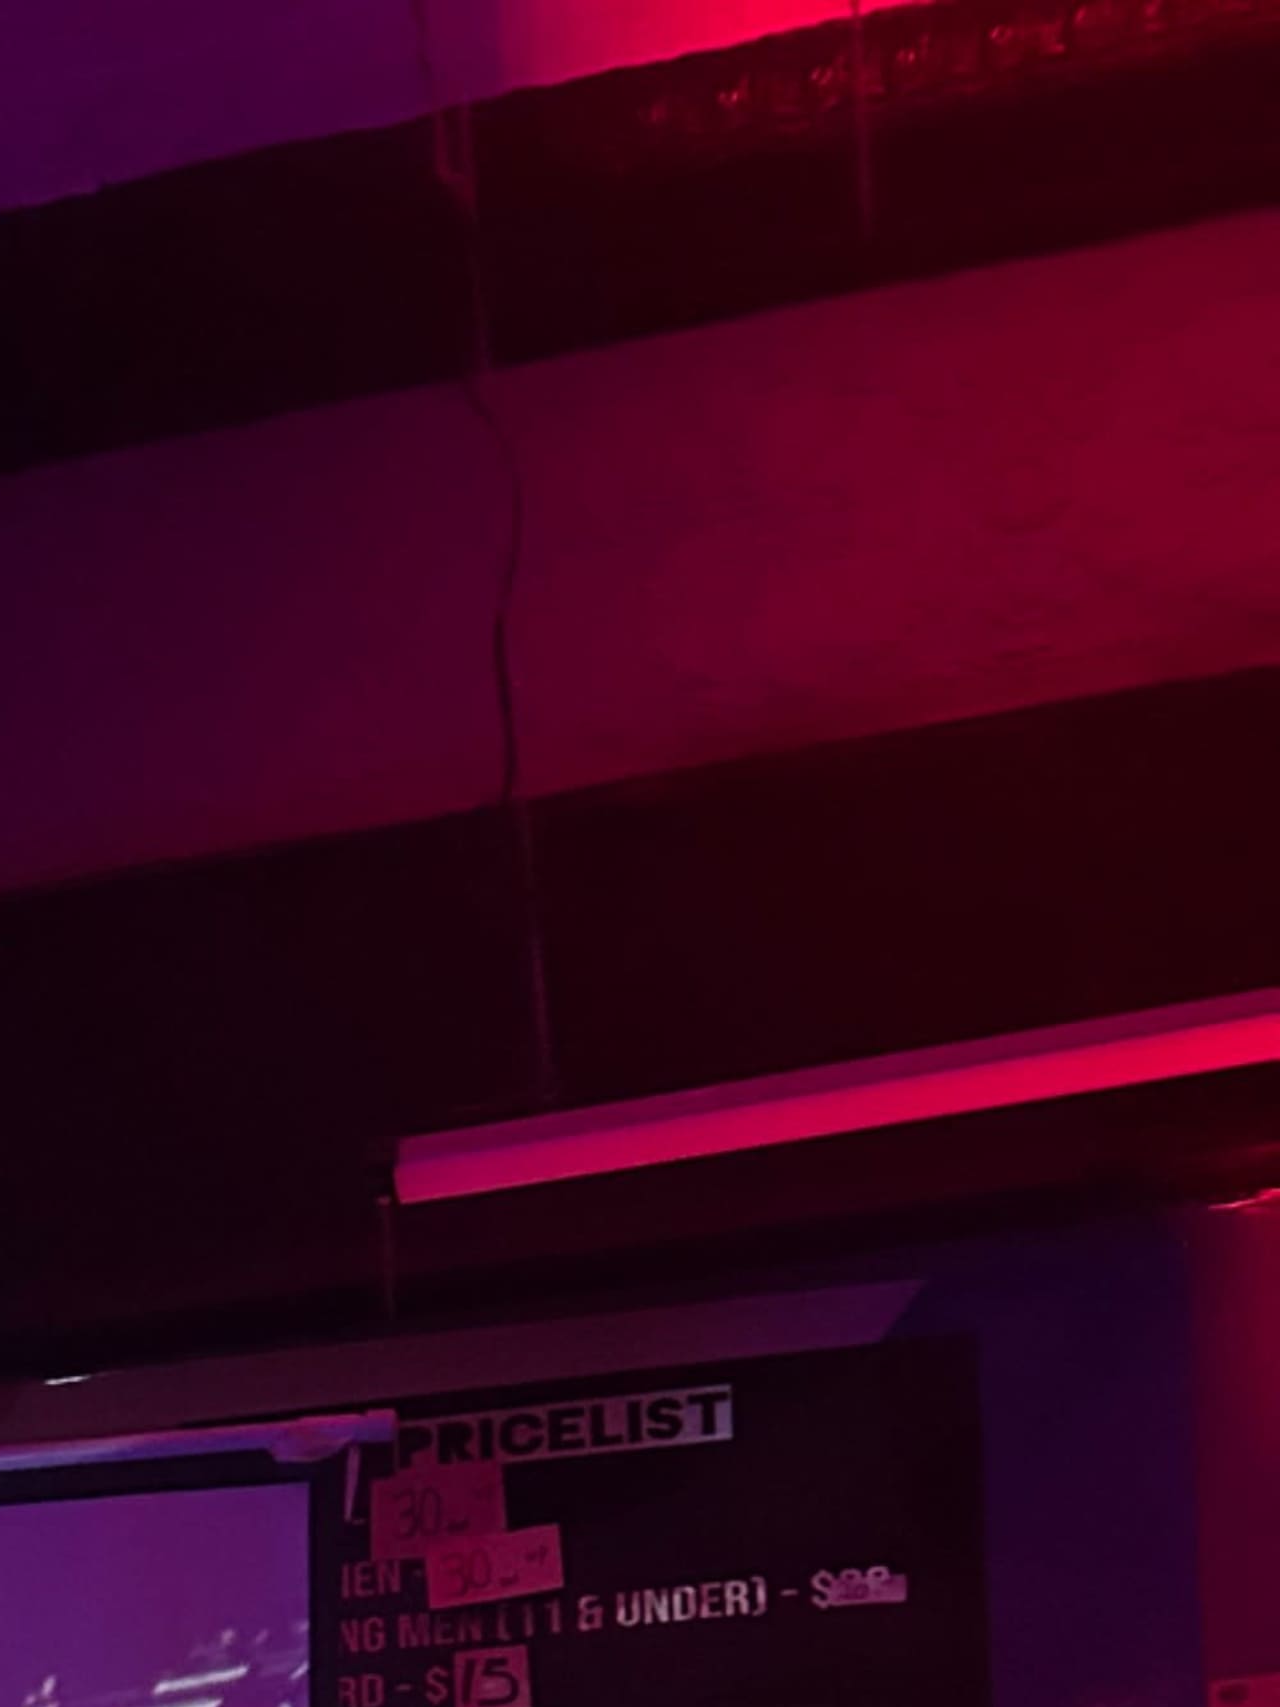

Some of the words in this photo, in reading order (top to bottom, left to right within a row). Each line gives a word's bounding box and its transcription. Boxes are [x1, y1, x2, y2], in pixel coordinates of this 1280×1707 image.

[400, 1391, 730, 1462] PRICELIST
[397, 1612, 484, 1648] MEN
[576, 1594, 604, 1631] &
